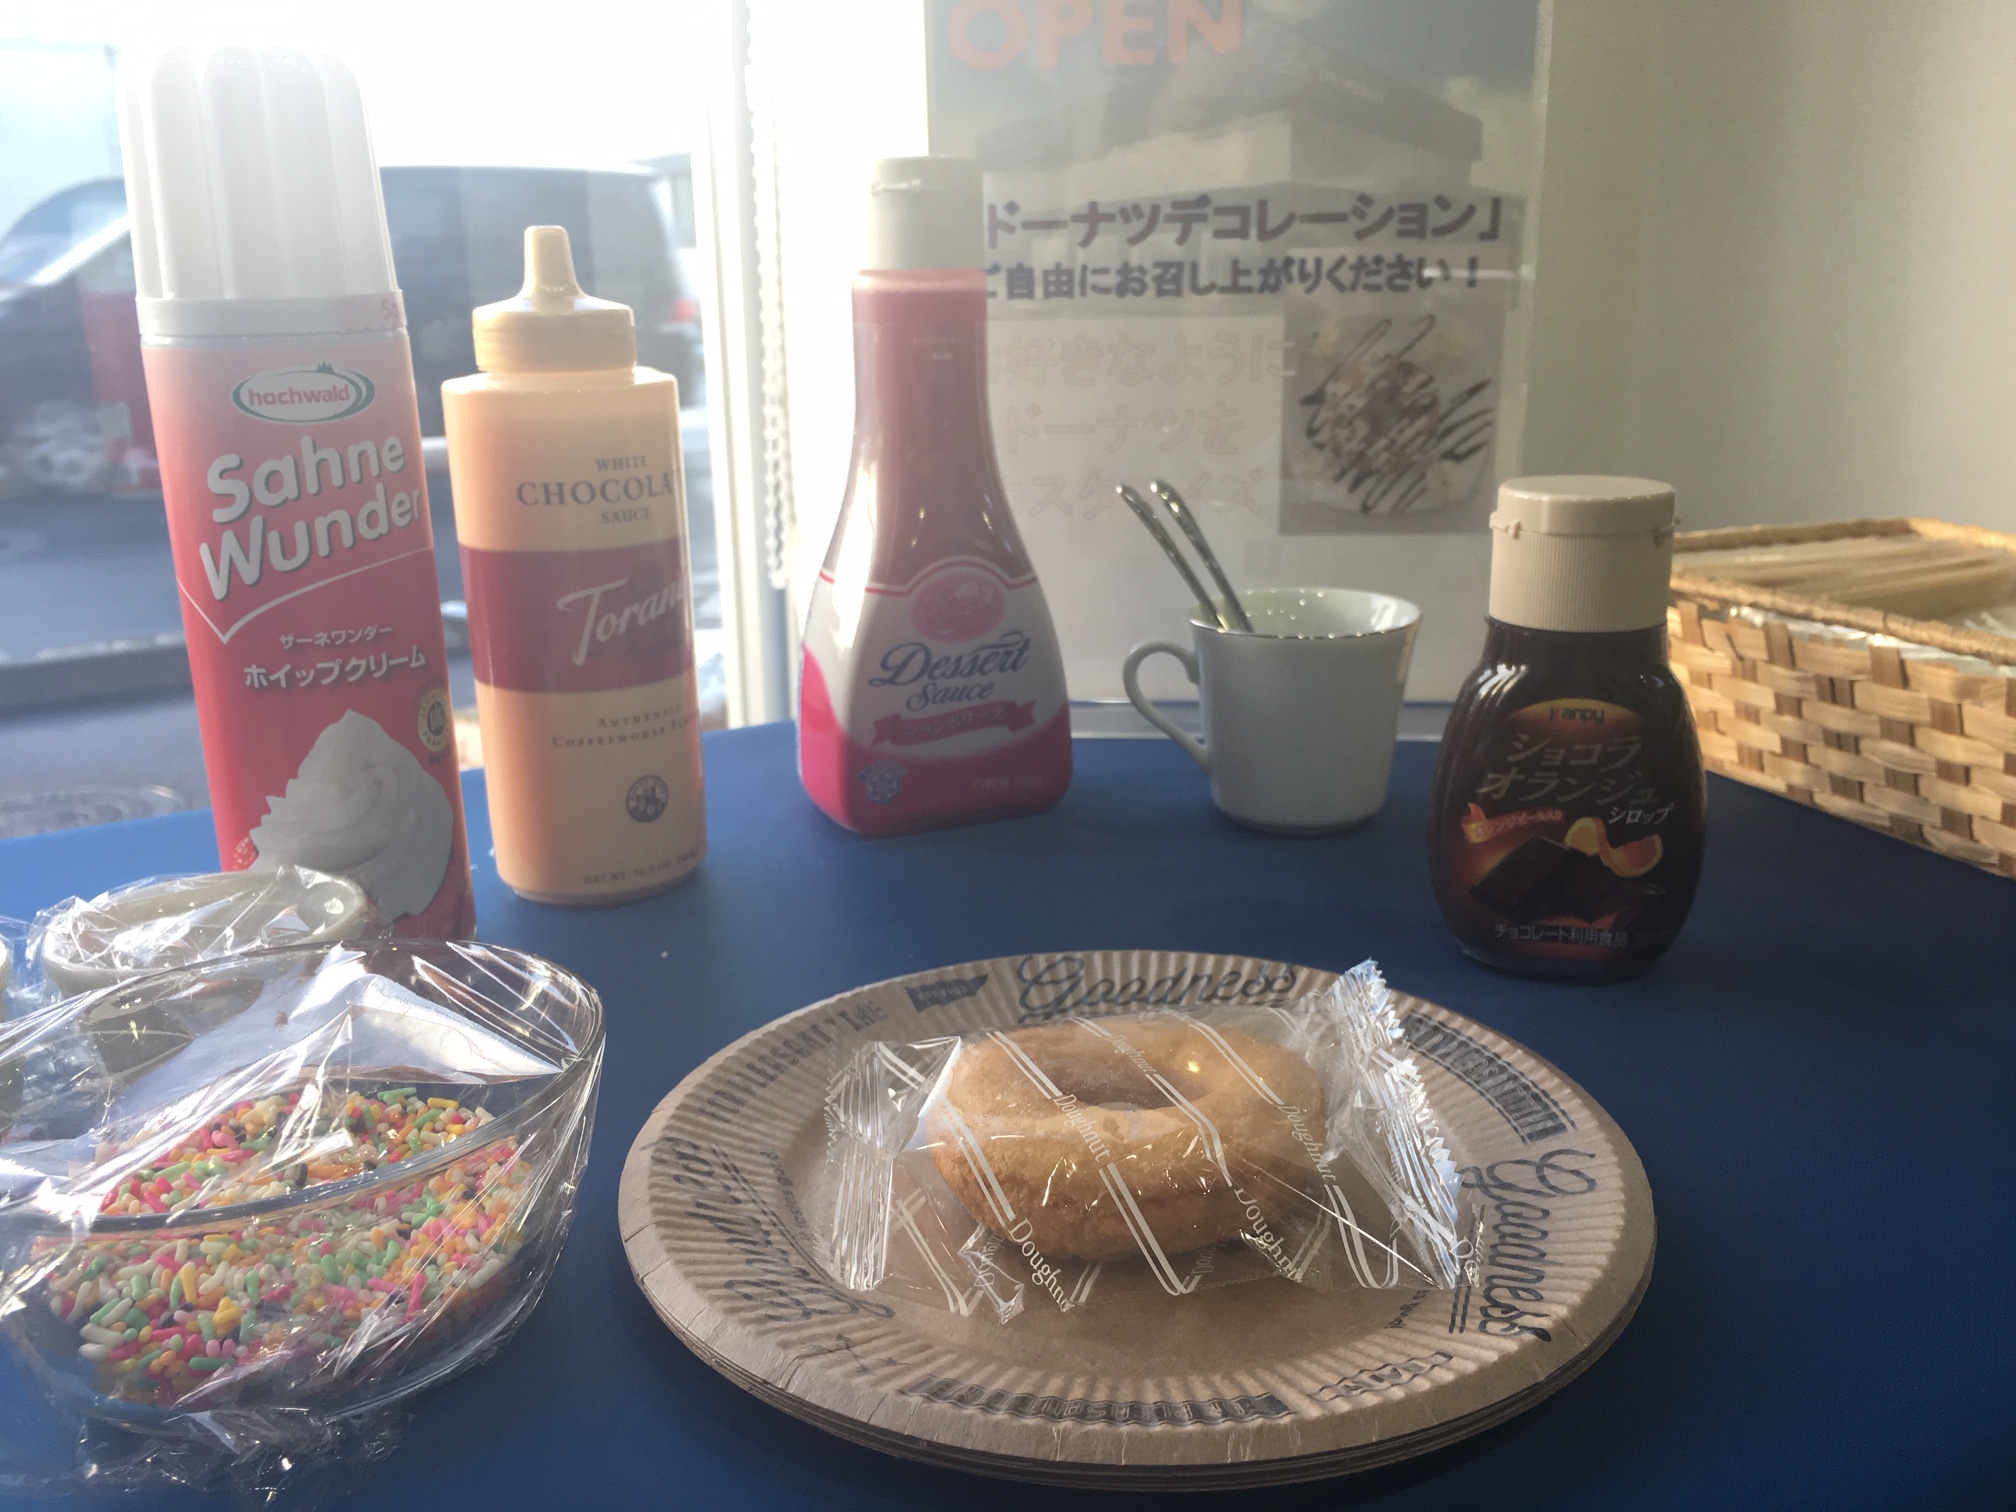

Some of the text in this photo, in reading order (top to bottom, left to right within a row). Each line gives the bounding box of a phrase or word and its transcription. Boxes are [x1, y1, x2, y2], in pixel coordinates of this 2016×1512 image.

[948, 0, 1243, 70] OPEN
[989, 332, 1298, 388] 好きなように
[249, 384, 349, 406] hochwald
[207, 435, 405, 525] Sahne
[517, 470, 680, 506] CHOCOLA
[595, 455, 647, 472] WHITE
[601, 506, 651, 525] SAUCE
[199, 482, 420, 602] Wunder
[557, 574, 688, 666] Toran
[244, 644, 426, 688] ホイップクリーム
[868, 630, 1031, 687] Dessert
[906, 682, 994, 712] Sauce
[1507, 733, 1642, 773] ショコラ
[1476, 767, 1662, 806] オランジュ
[1609, 803, 1675, 825] シロップ
[1494, 924, 1629, 949] チョコレート利用食品
[1018, 954, 1297, 1023] Goodness
[1053, 1093, 1111, 1162] Doughnut
[1276, 1105, 1337, 1182] Doughnut
[1459, 1148, 1598, 1343] Goodness
